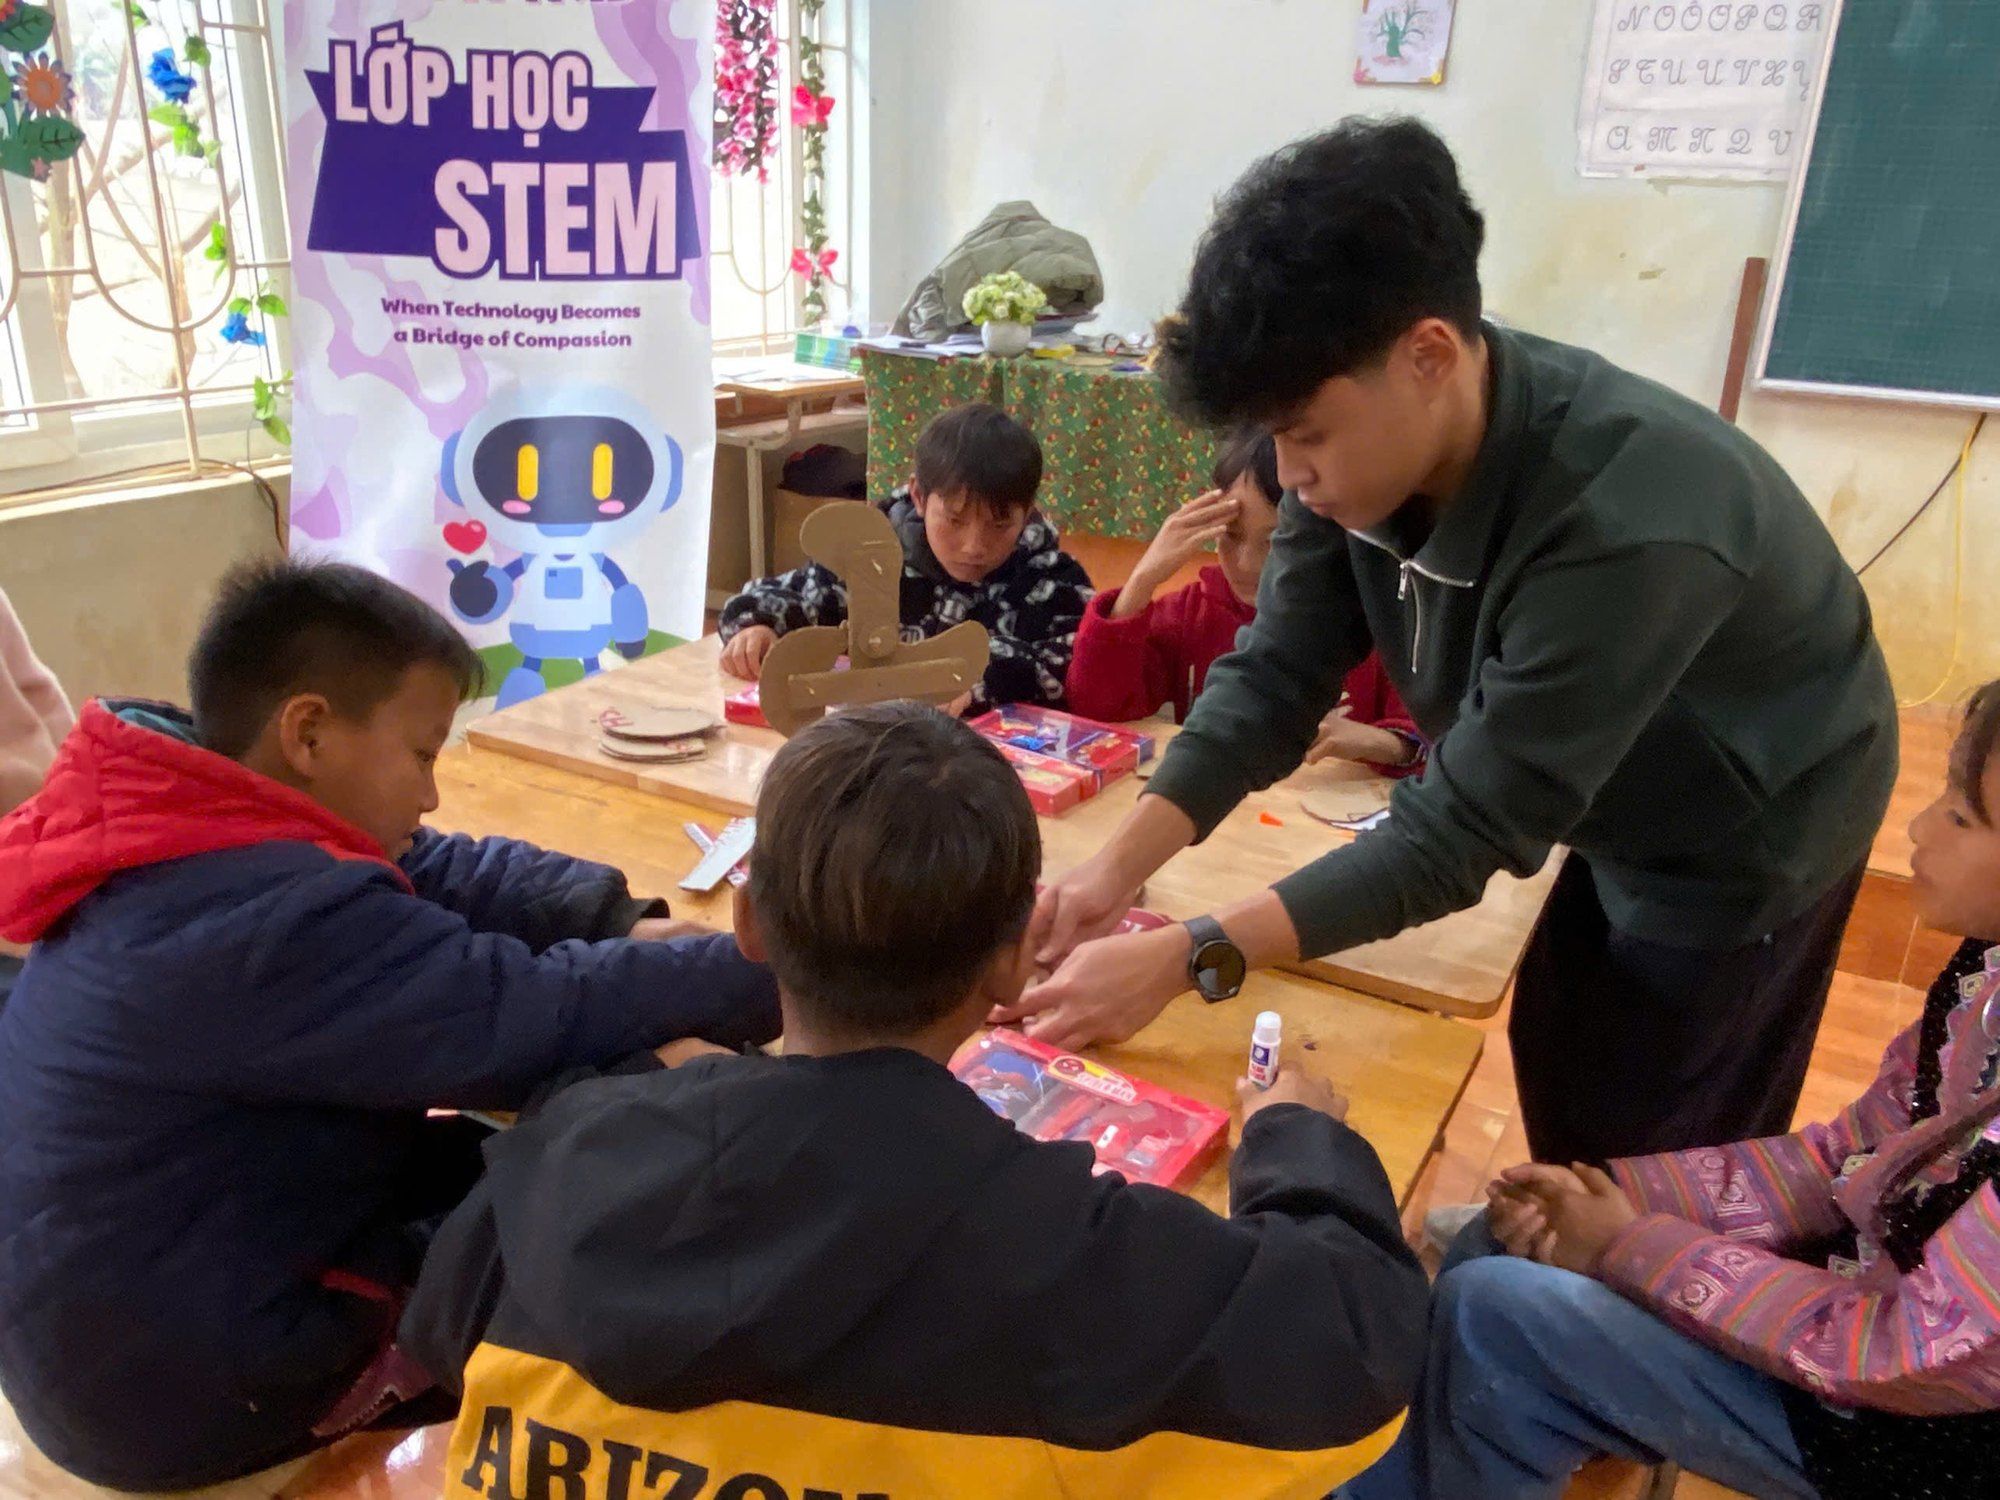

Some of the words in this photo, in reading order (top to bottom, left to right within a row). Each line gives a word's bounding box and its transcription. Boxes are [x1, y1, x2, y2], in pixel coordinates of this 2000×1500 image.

[1654, 5, 1676, 31] O
[1735, 4, 1759, 31] P
[1764, 4, 1788, 31] Q
[335, 27, 449, 126] LỚP
[472, 54, 589, 147] HỌC
[434, 160, 677, 275] STEM
[381, 298, 440, 316] When
[443, 300, 558, 323] Technology
[561, 304, 641, 319] Becomes
[394, 331, 408, 343] a
[413, 327, 484, 349] Bridge
[489, 330, 509, 347] of
[514, 331, 632, 350] Compassion
